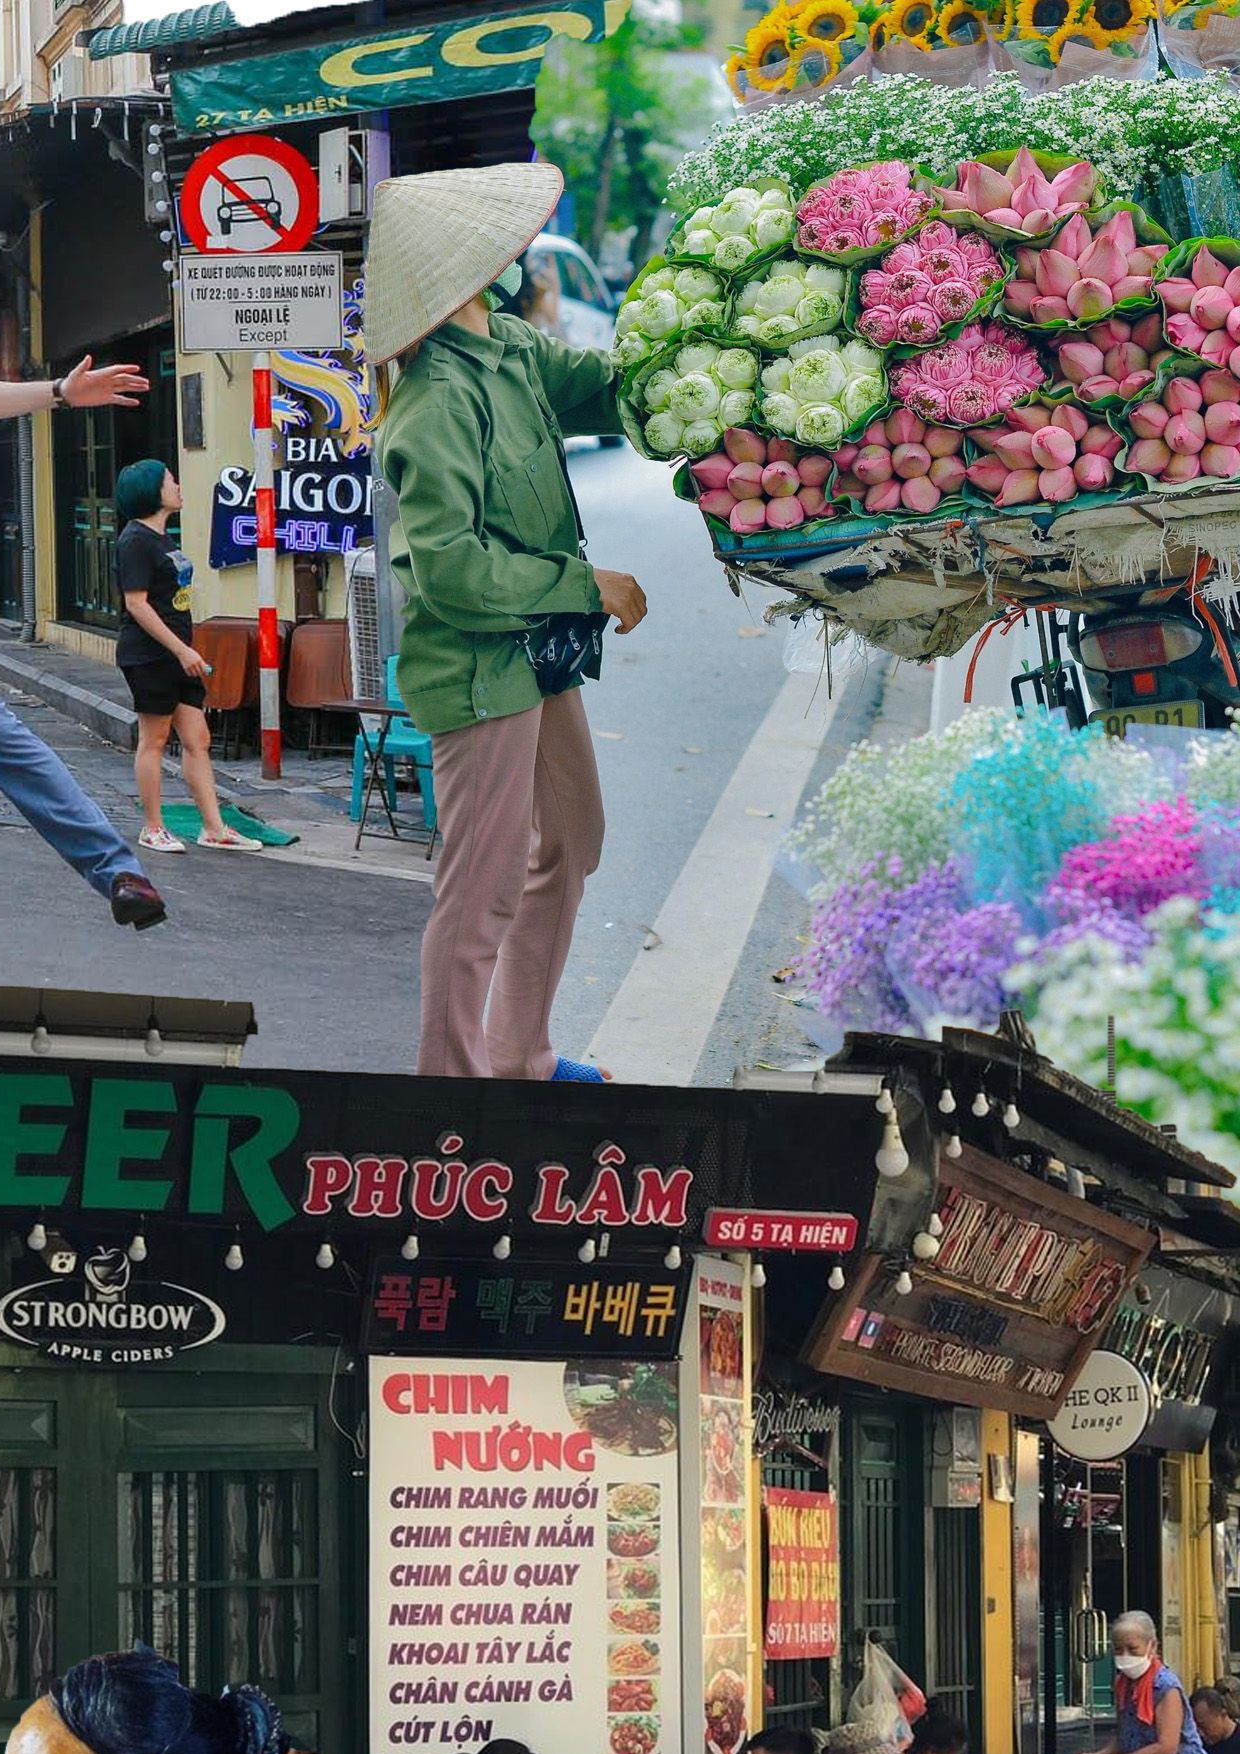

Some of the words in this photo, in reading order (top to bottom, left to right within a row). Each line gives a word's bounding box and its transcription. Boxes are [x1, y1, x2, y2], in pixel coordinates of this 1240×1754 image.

[195, 112, 225, 128] 27
[188, 267, 199, 279] XE
[235, 308, 272, 326] NGOẠI
[276, 304, 290, 326] LỆ
[239, 328, 287, 345] Except
[286, 437, 339, 462] BIA
[1189, 520, 1237, 533] SINOPEC
[303, 1135, 513, 1222] PHÚC
[531, 1141, 694, 1226] LÂM
[718, 1214, 746, 1240] SỐ
[751, 1222, 764, 1241] 5
[770, 1224, 794, 1248] TẠ
[799, 1219, 848, 1249] HIỆN
[12, 1301, 194, 1331] STRONGBOW
[475, 1277, 553, 1333] 맥주
[563, 1280, 677, 1337] 바베큐
[47, 1342, 103, 1363] APPLE
[111, 1346, 174, 1363] CIDERS
[382, 1373, 510, 1415] CHIM
[1064, 1389, 1090, 1408] HE
[1094, 1387, 1122, 1406] QK
[1071, 1414, 1123, 1432] Lounge
[432, 1420, 596, 1472] NƯỚNG
[390, 1486, 452, 1509] CHIM
[458, 1486, 528, 1510] RANG
[532, 1477, 599, 1510] MUỐI
[390, 1525, 452, 1548] CHIM
[458, 1520, 530, 1548] CHIÊN
[535, 1514, 595, 1548] MẮM
[390, 1565, 452, 1588] CHIM
[458, 1559, 508, 1587] CÂU
[513, 1564, 581, 1589] QUAY
[388, 1603, 444, 1626] NEM
[450, 1603, 514, 1626] CHUA
[520, 1596, 573, 1625] RÁN
[388, 1642, 469, 1665] KHOAI
[475, 1636, 522, 1664] TÂY
[526, 1629, 572, 1664] LẮC
[389, 1676, 458, 1705] CHÂN
[464, 1674, 532, 1703] CÁNH
[538, 1673, 574, 1702] GÀ
[389, 1715, 436, 1744] CÚT
[440, 1714, 493, 1749] LỘN
